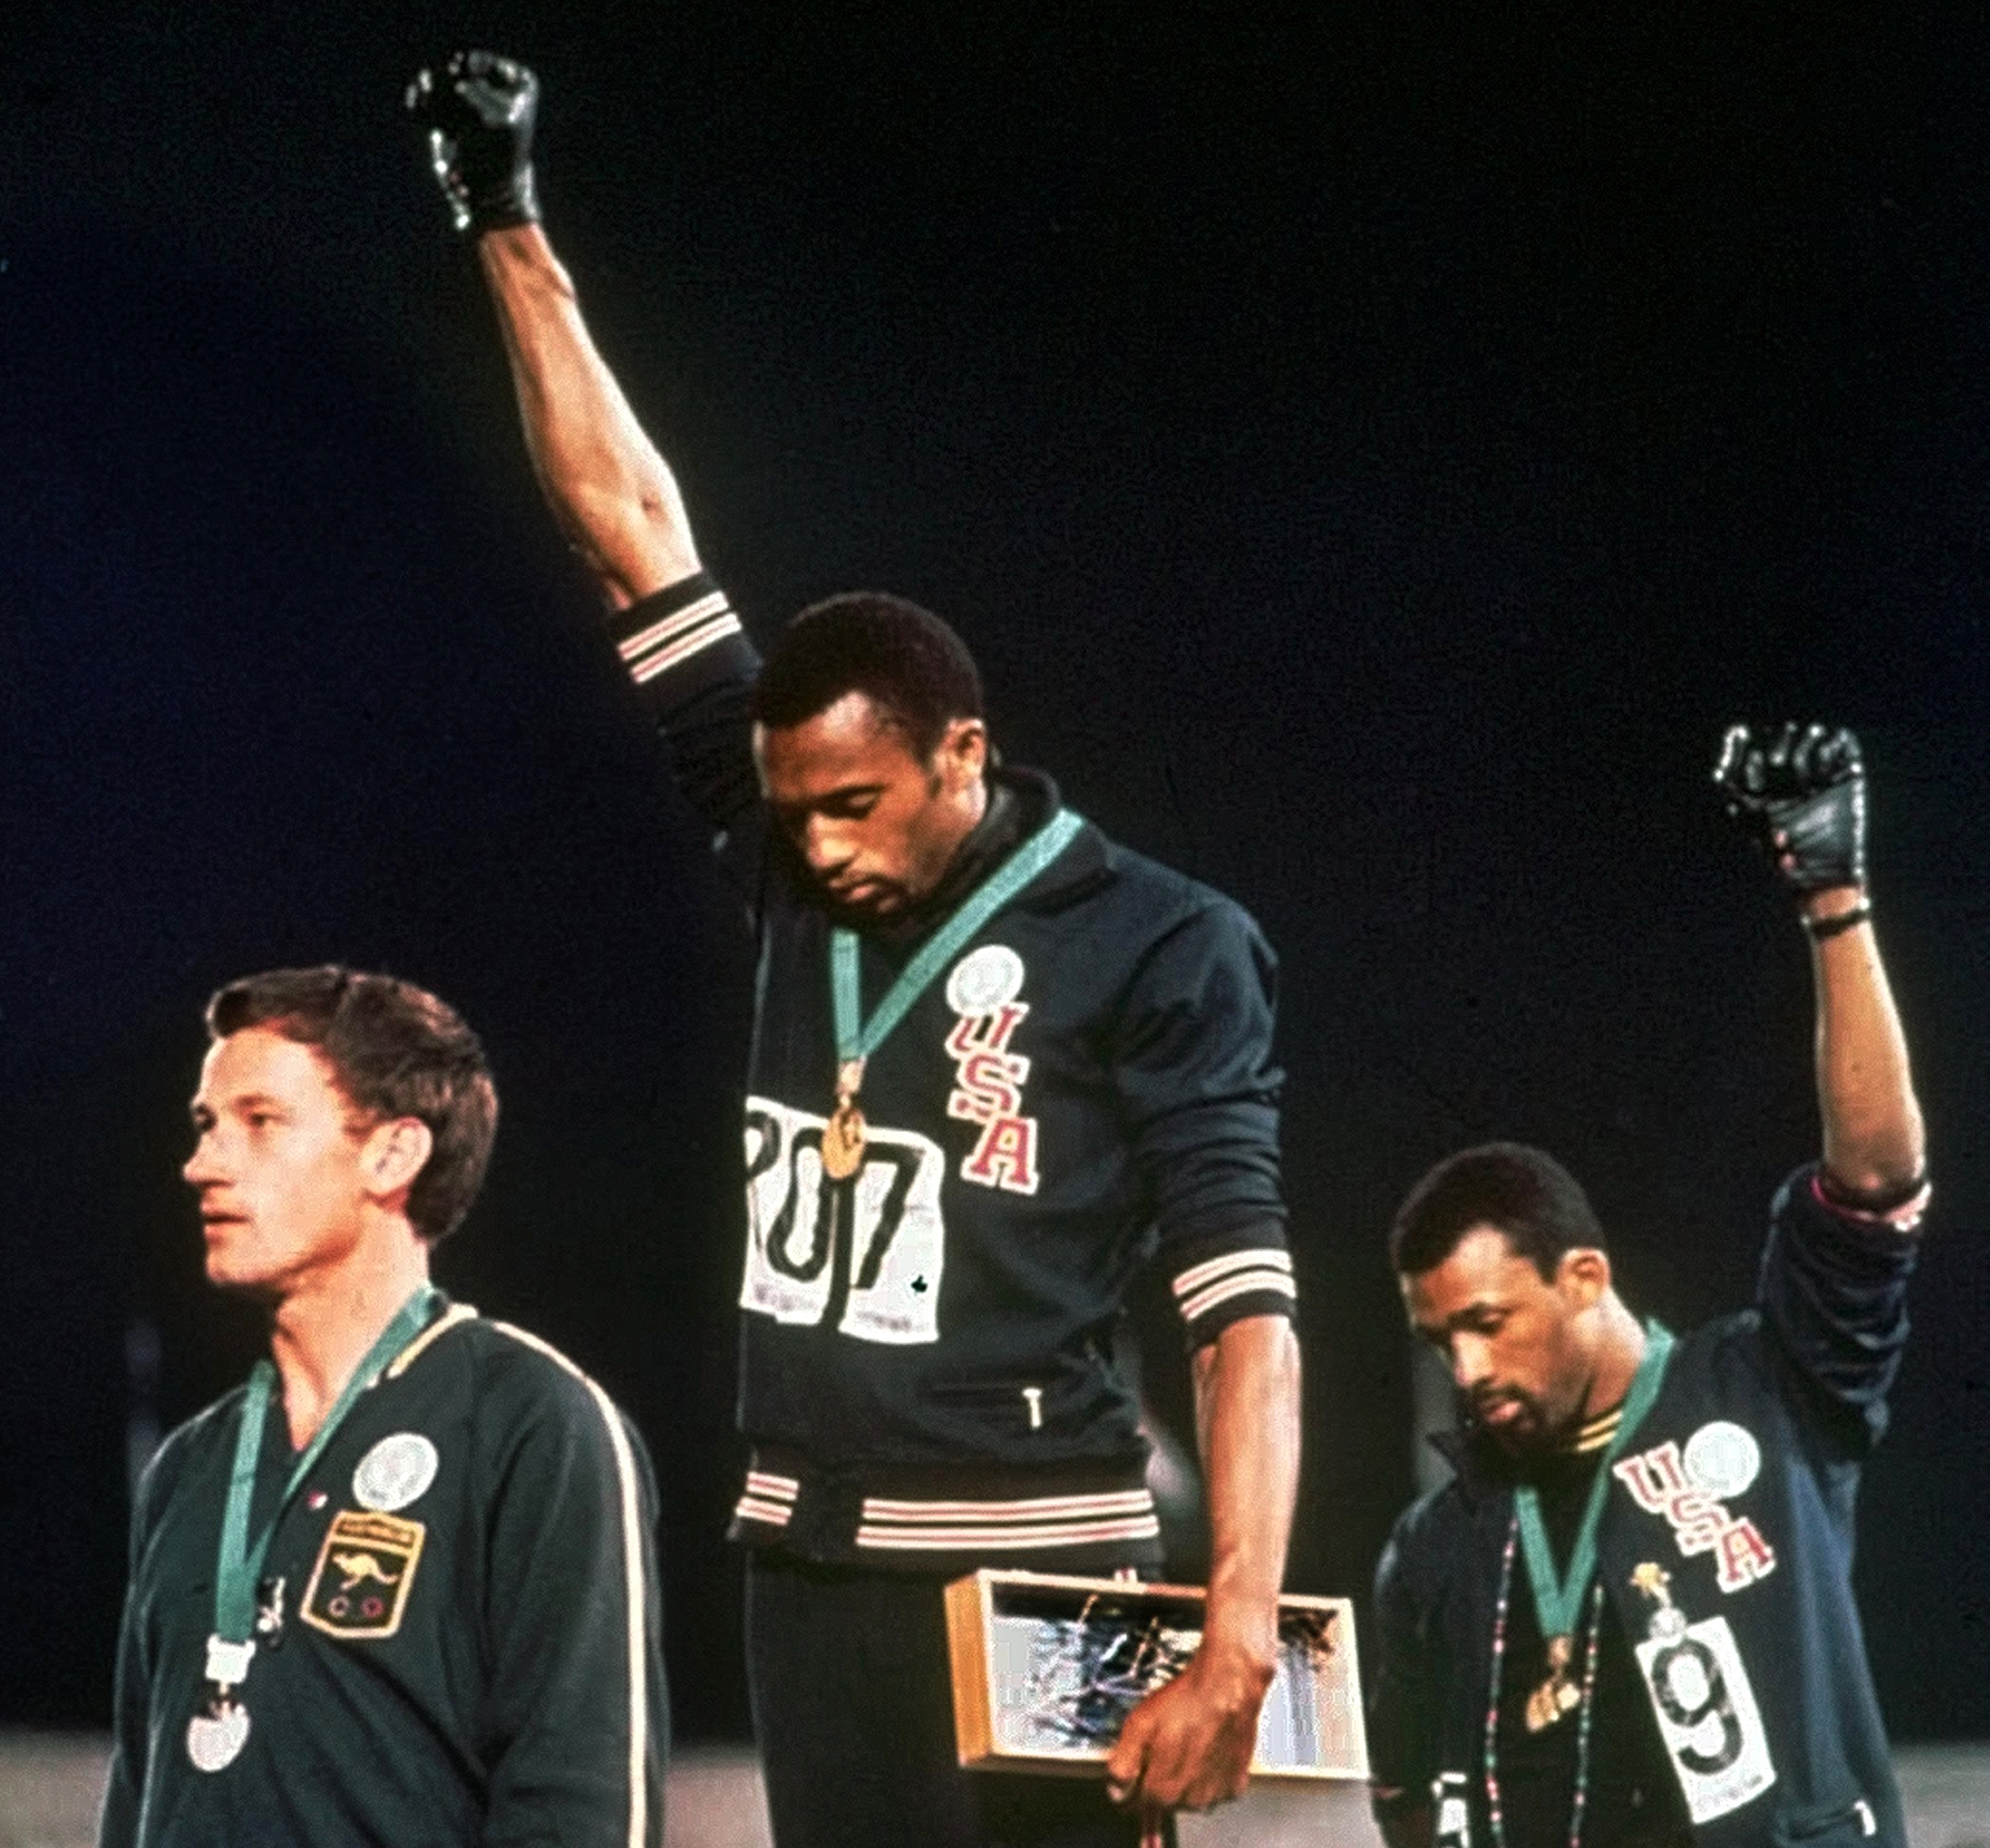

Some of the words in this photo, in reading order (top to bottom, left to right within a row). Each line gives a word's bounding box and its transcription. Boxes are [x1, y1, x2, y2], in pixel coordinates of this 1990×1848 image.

[945, 1001, 1039, 1196] USA
[1612, 1441, 1776, 1594] USA
[1650, 1637, 1744, 1776] 9
